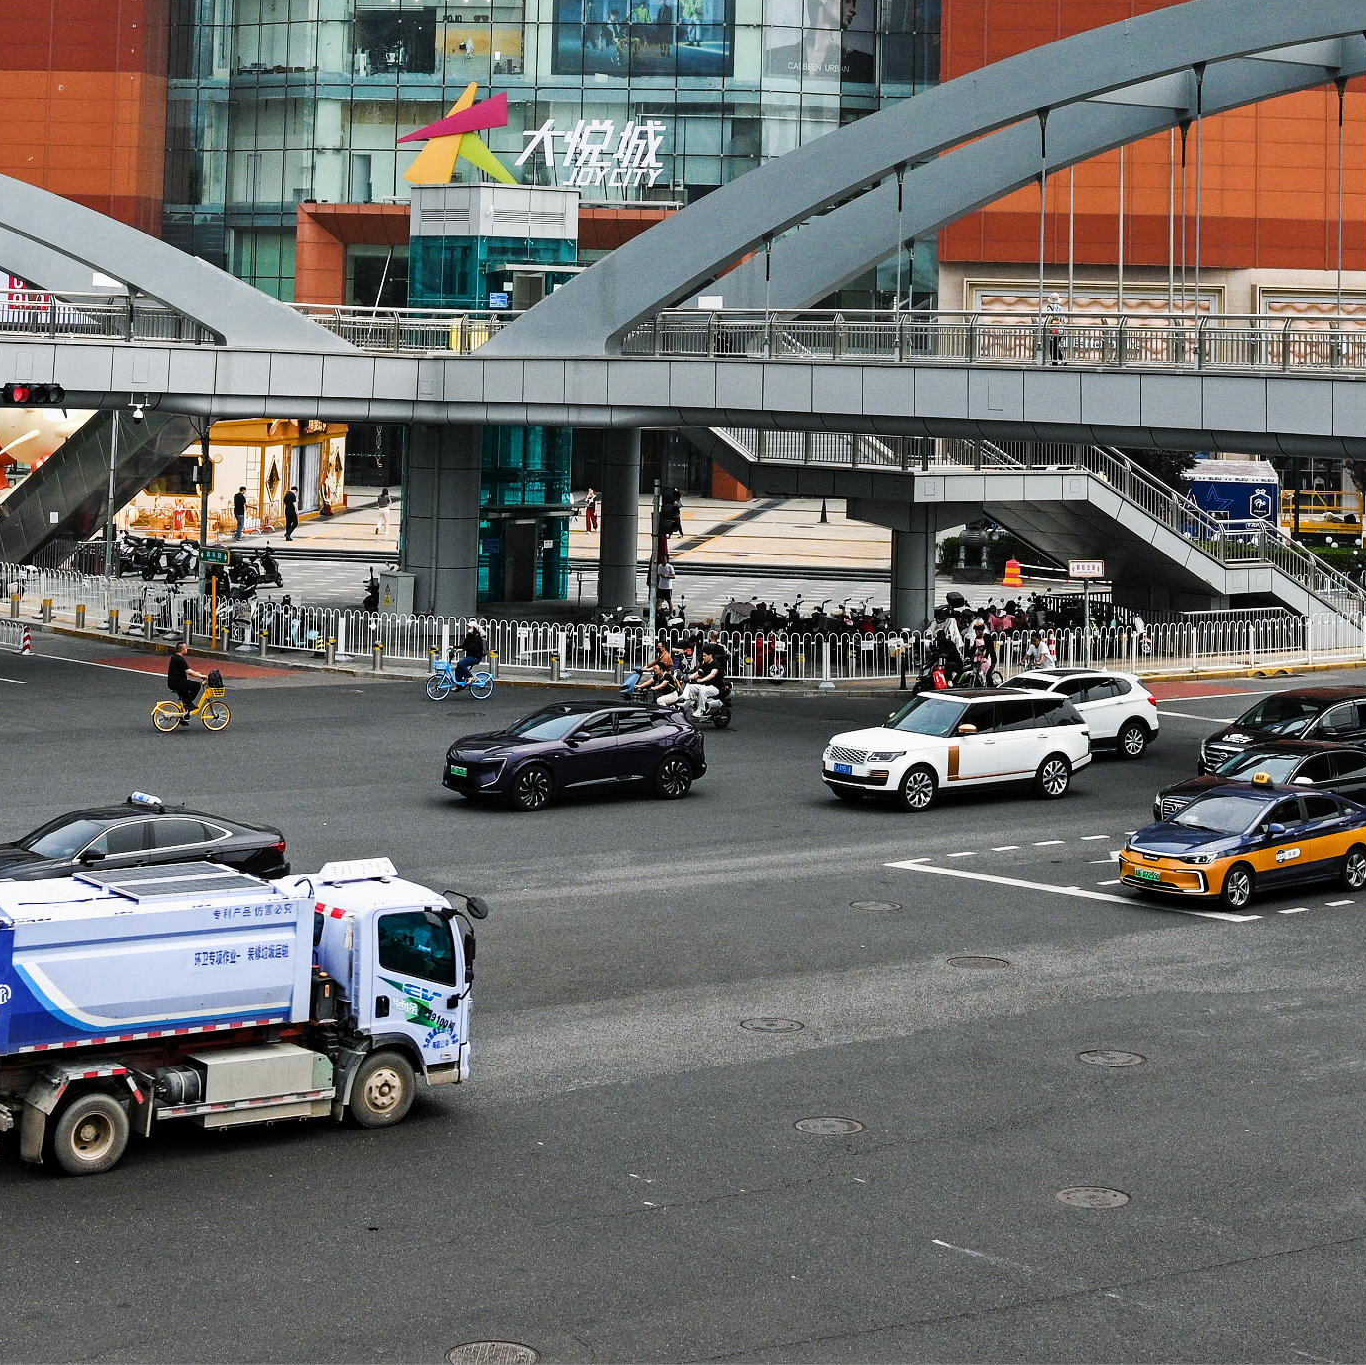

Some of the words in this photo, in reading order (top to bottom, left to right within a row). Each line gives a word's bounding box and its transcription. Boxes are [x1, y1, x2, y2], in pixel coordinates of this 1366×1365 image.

[514, 119, 667, 168] 大悦城
[563, 168, 611, 186] JOY
[608, 168, 665, 188] CITY
[213, 906, 251, 920] 专利产品
